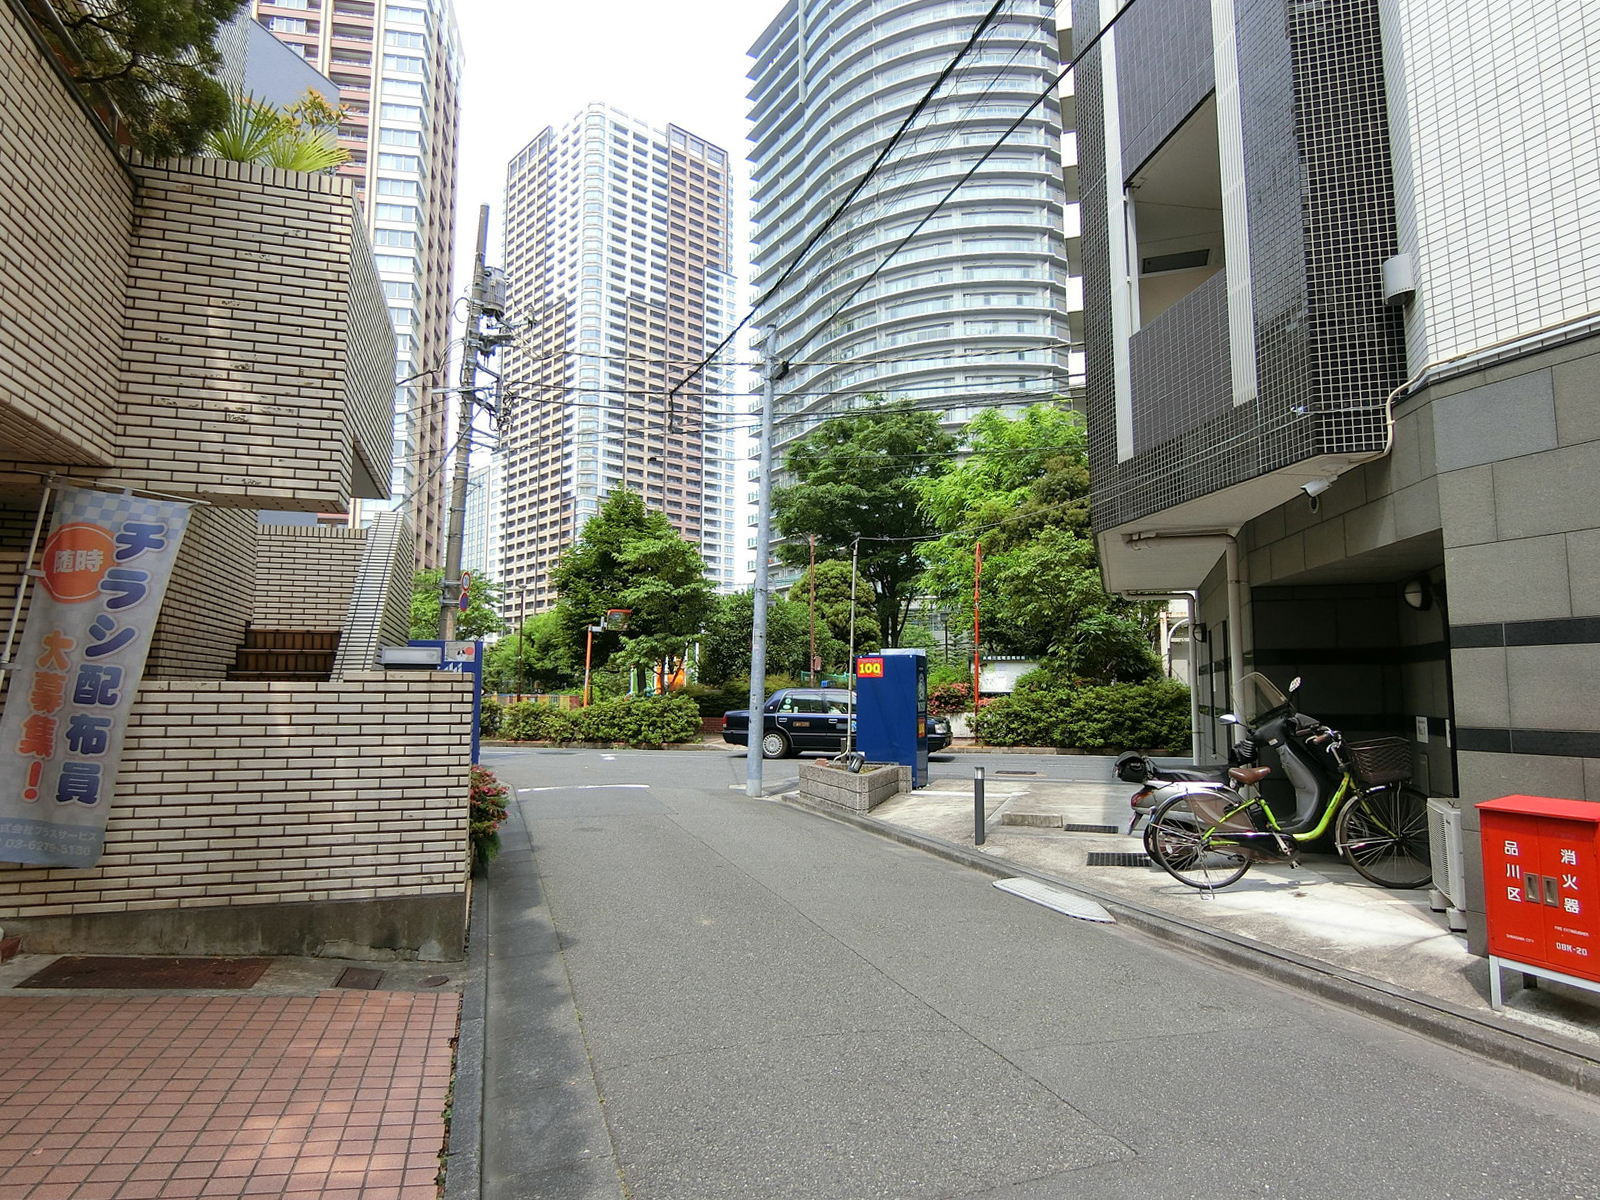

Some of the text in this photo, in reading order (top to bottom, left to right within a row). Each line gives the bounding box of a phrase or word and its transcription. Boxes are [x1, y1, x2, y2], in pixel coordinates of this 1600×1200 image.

[54, 549, 104, 574] 随時
[56, 521, 167, 806] チラシ配布員
[859, 663, 881, 674] 100
[1504, 841, 1521, 902] 品川区
[1560, 849, 1579, 913] 消火器
